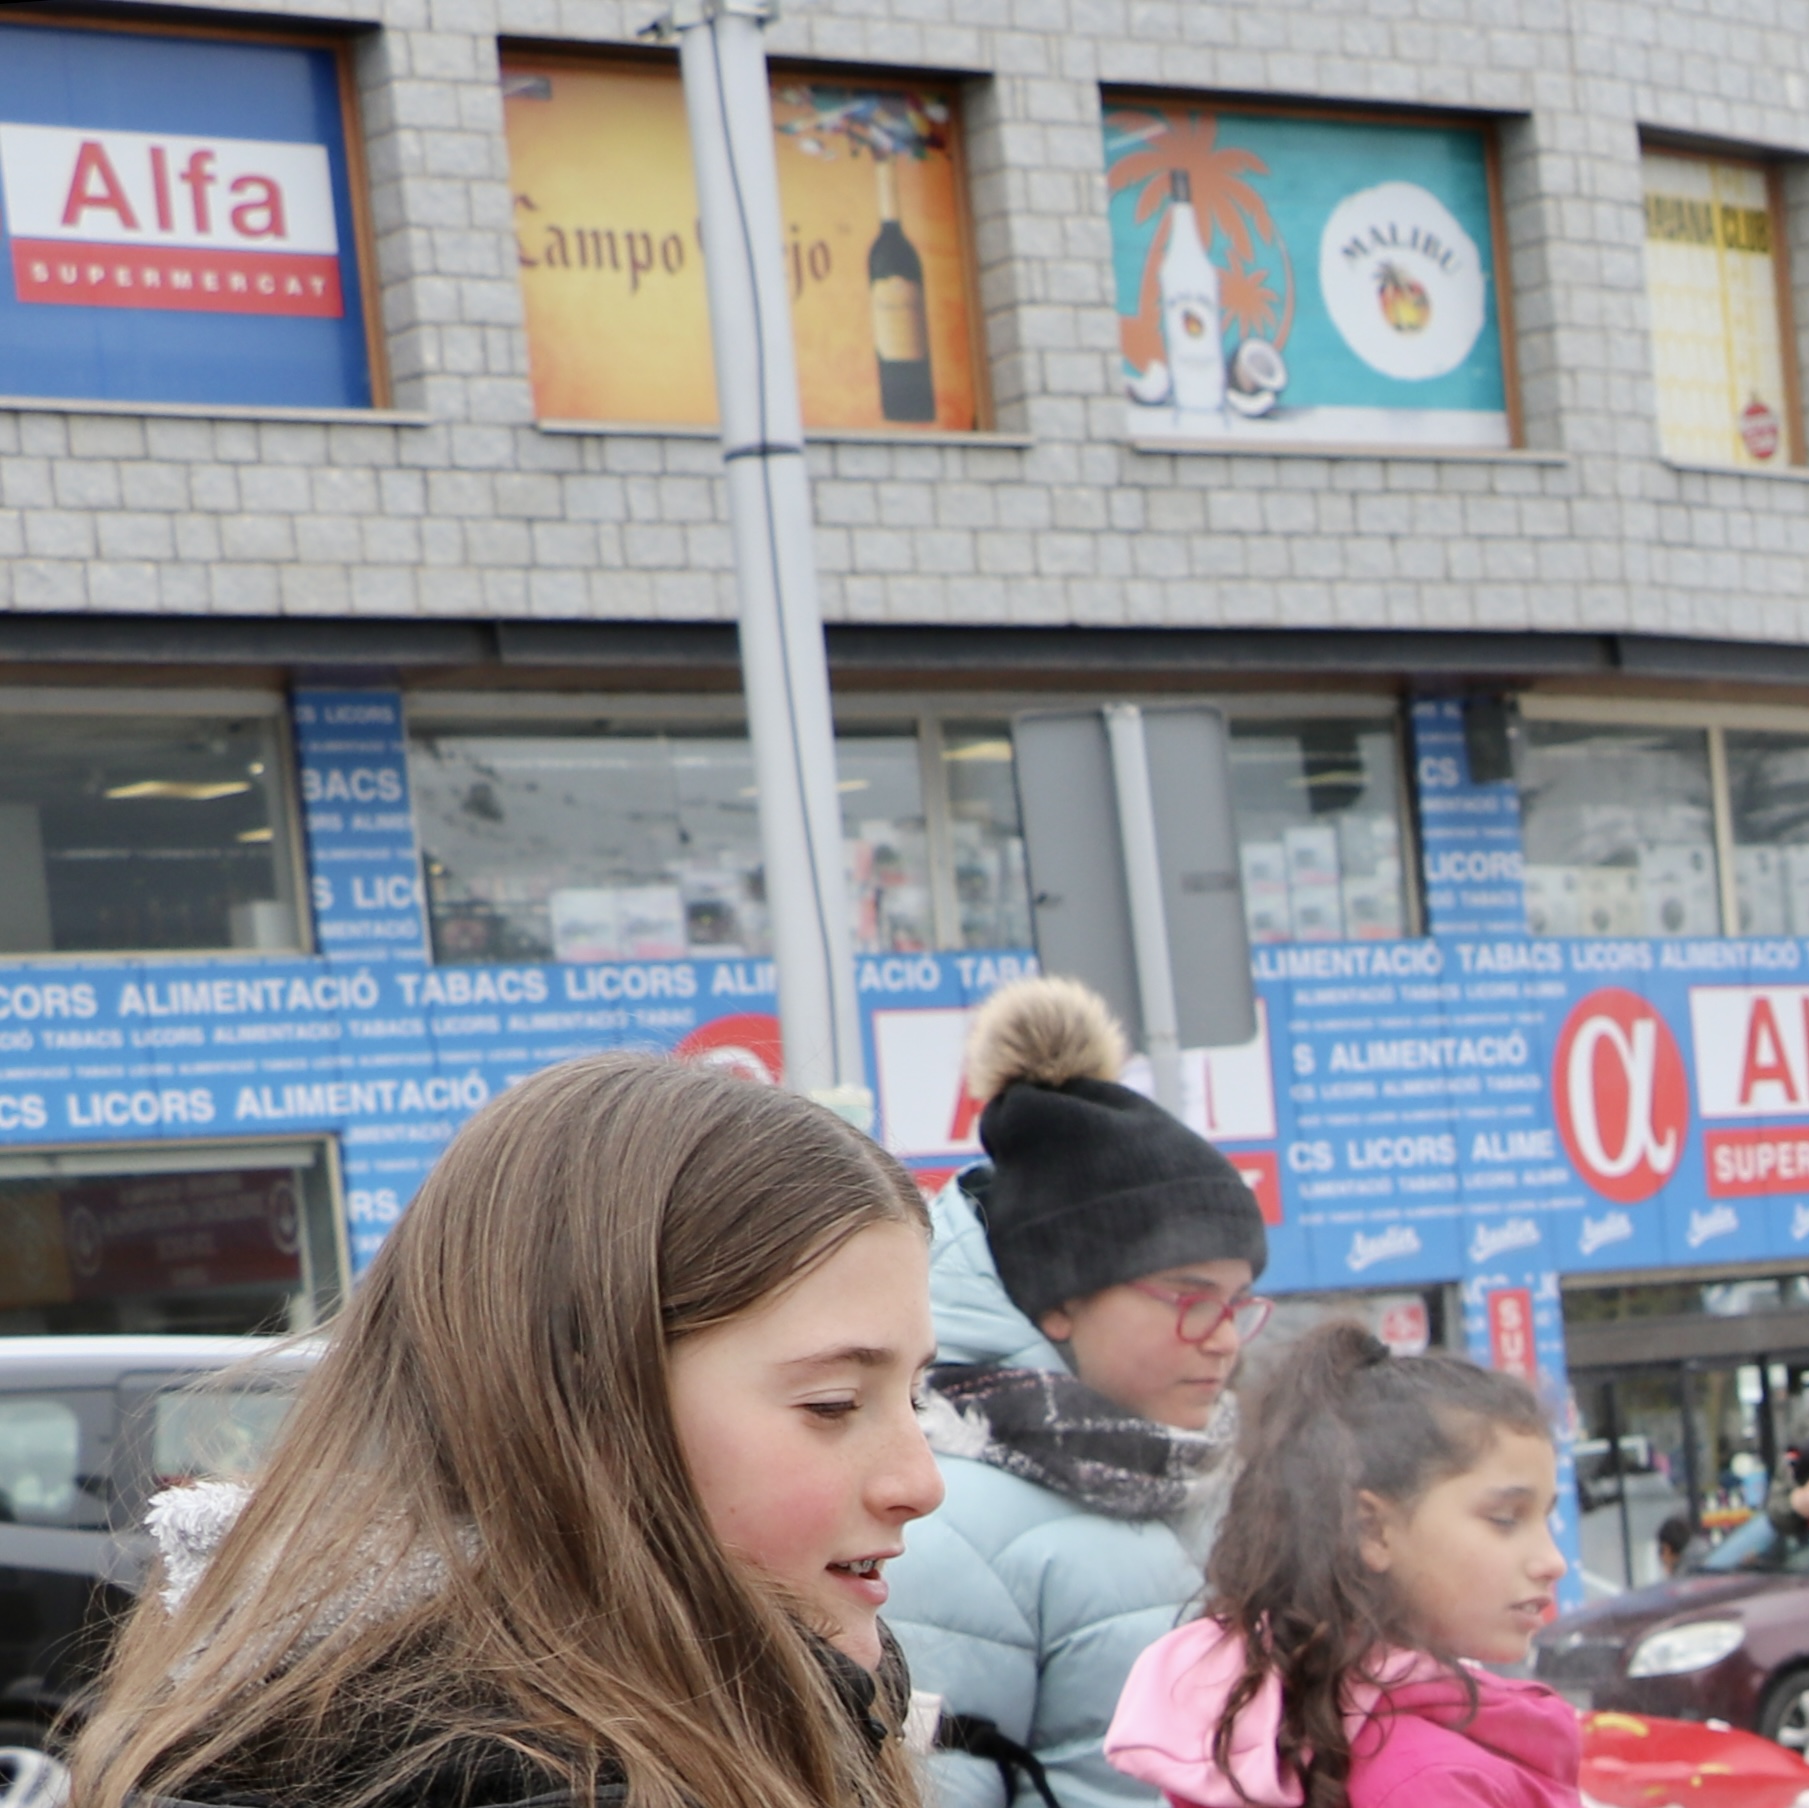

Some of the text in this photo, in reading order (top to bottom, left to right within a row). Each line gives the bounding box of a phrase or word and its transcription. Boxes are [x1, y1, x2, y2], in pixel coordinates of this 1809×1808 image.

[60, 140, 288, 240] Alfa
[1341, 222, 1464, 275] MALIBU
[29, 261, 328, 297] SUPERMERCAT
[1457, 941, 1562, 973] TABACS
[1571, 941, 1654, 971] LICORS
[1660, 936, 1799, 969] ALIMENTACIÓ
[118, 966, 380, 1018] ALIMENTACIÓ
[395, 968, 548, 1006] TABACS
[564, 964, 698, 1001] LICORS
[1328, 1027, 1529, 1074] ALIMENTACIÓ
[66, 1088, 216, 1127] LICORS
[234, 1068, 489, 1120] ALIMENTACIÓ
[1287, 1140, 1334, 1173] CS
[1346, 1133, 1457, 1171] LICORS
